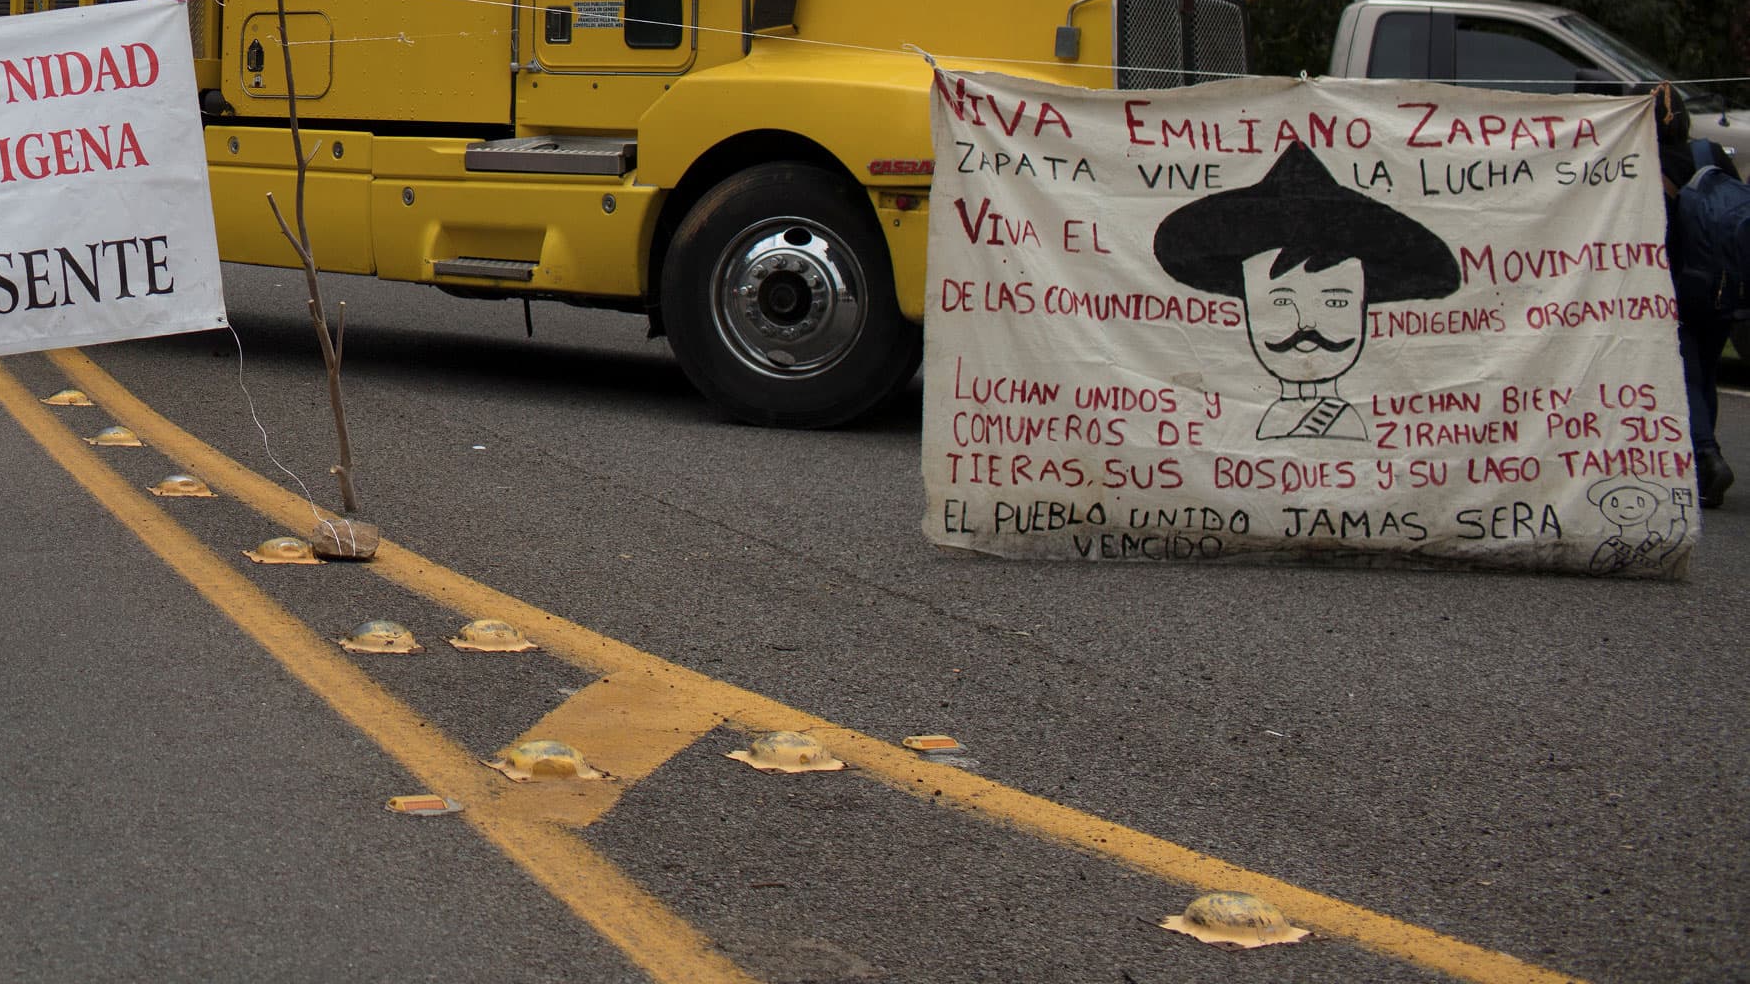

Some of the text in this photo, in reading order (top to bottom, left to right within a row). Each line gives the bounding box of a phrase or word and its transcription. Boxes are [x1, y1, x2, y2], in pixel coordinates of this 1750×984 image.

[935, 78, 1599, 153] VIVA EMILIANO ZAPATA
[955, 141, 1640, 196] ZAPATA VIVE LA LUCHA SIGUE
[954, 197, 1042, 247] VIVA
[1064, 220, 1111, 254] EL
[941, 278, 975, 312] DE
[984, 281, 1035, 313] LAS
[1045, 286, 1241, 326] COMUNIDADES
[1368, 309, 1507, 338] INDIGENAS
[955, 356, 1060, 407] LUCHAN
[1075, 386, 1177, 413] UNIDOS
[1371, 392, 1481, 417] LUCHAN
[1502, 386, 1573, 414] BIEN
[1599, 383, 1657, 411] LOS
[953, 412, 1683, 450] COMUNEROS DE ZIRAHUEN POR SUS
[1102, 458, 1184, 490] SUS
[1213, 456, 1356, 494] BOSQUES
[1409, 460, 1448, 488] SU
[1467, 456, 1540, 484] LAGO
[1558, 449, 1693, 479] TAMBIEN
[944, 499, 1563, 541] EL PUEBLO UNIDO JAMAS SERA
[1073, 534, 1223, 561] VENCIDO
